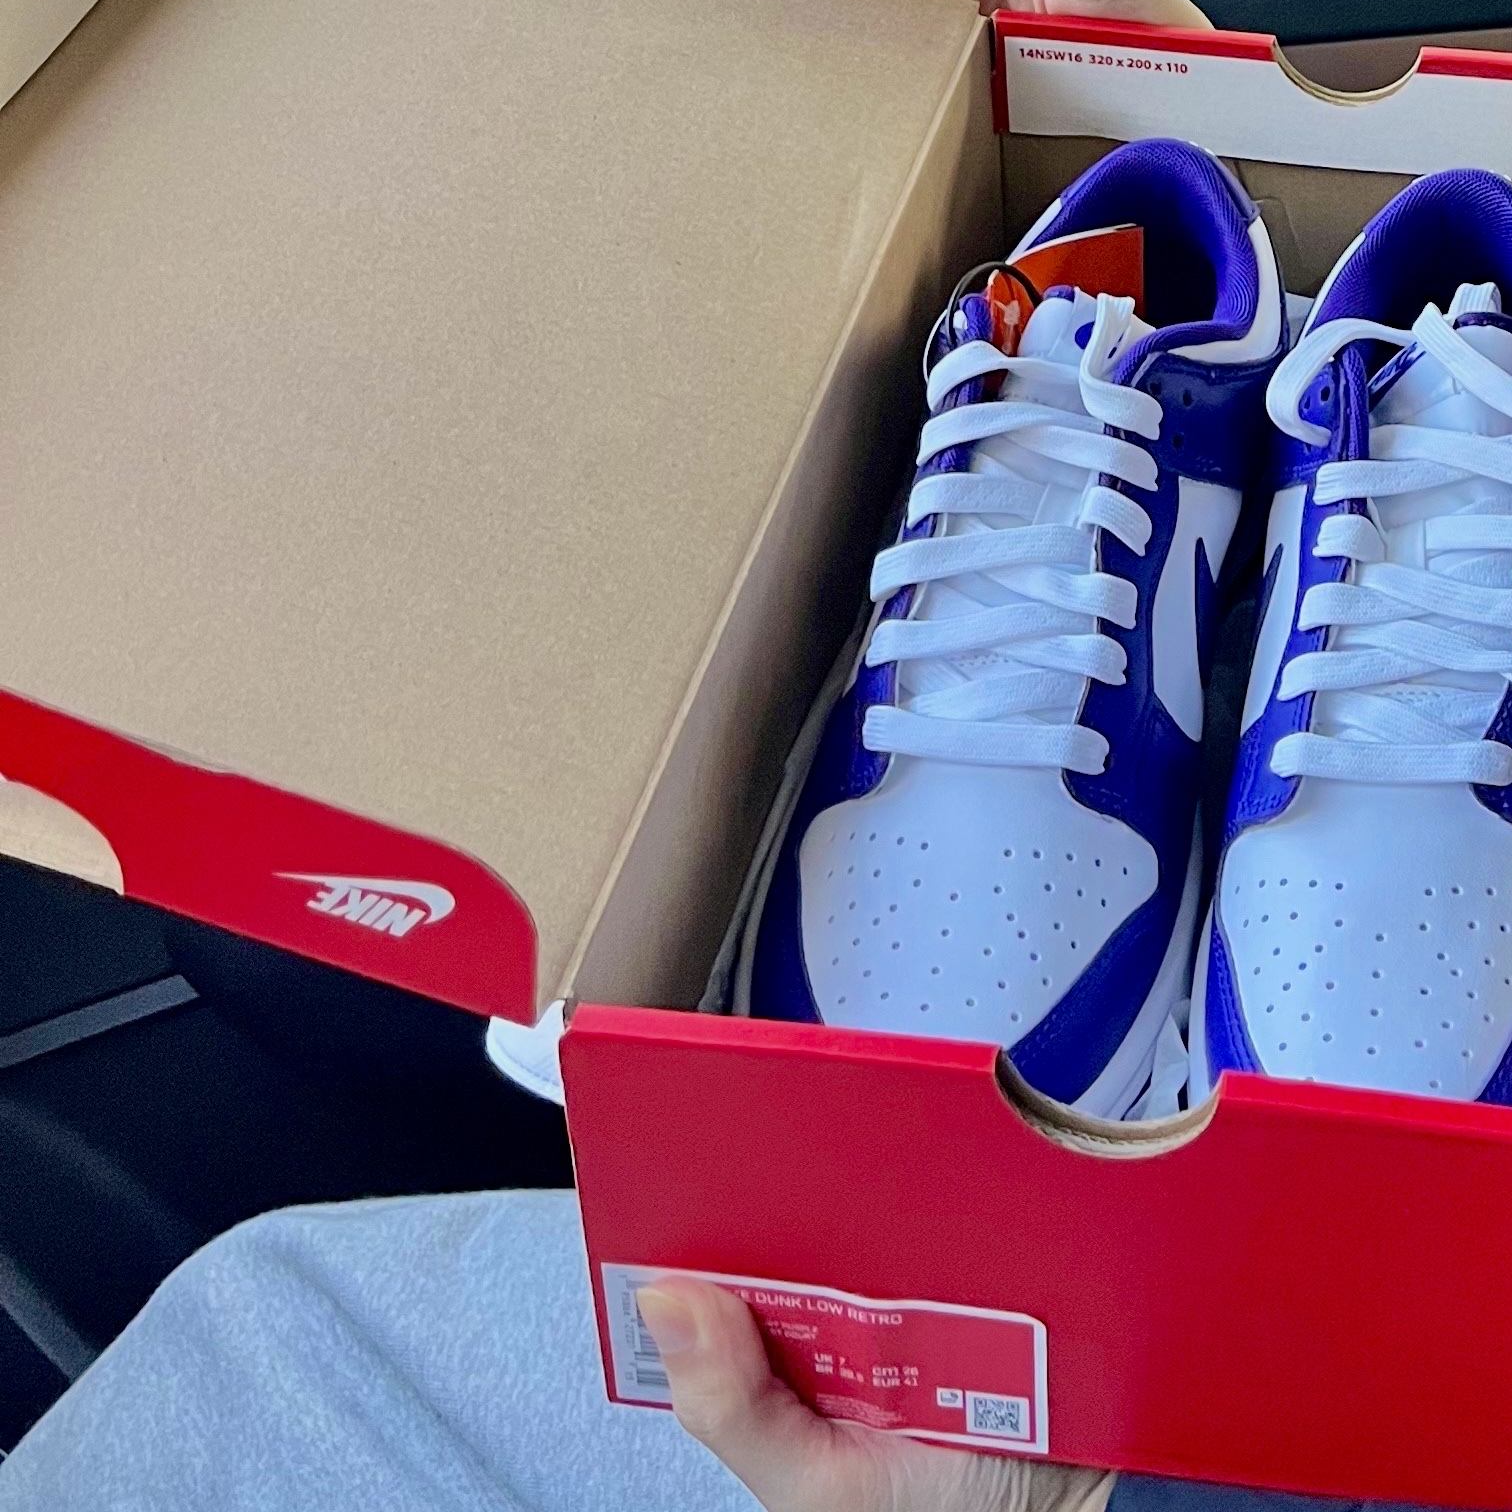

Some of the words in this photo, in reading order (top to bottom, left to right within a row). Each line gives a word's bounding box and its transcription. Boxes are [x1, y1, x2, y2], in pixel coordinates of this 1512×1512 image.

[1018, 47, 1083, 63] 14NSW16
[1089, 53, 1113, 67] 320
[1116, 58, 1125, 67] x
[1127, 57, 1152, 71] 200
[1154, 63, 1163, 72] x
[1166, 61, 1189, 74] 110
[307, 882, 427, 937] NIKE
[755, 1292, 802, 1309] DUNK
[806, 1298, 844, 1316] LOW
[847, 1307, 903, 1325] RETRO
